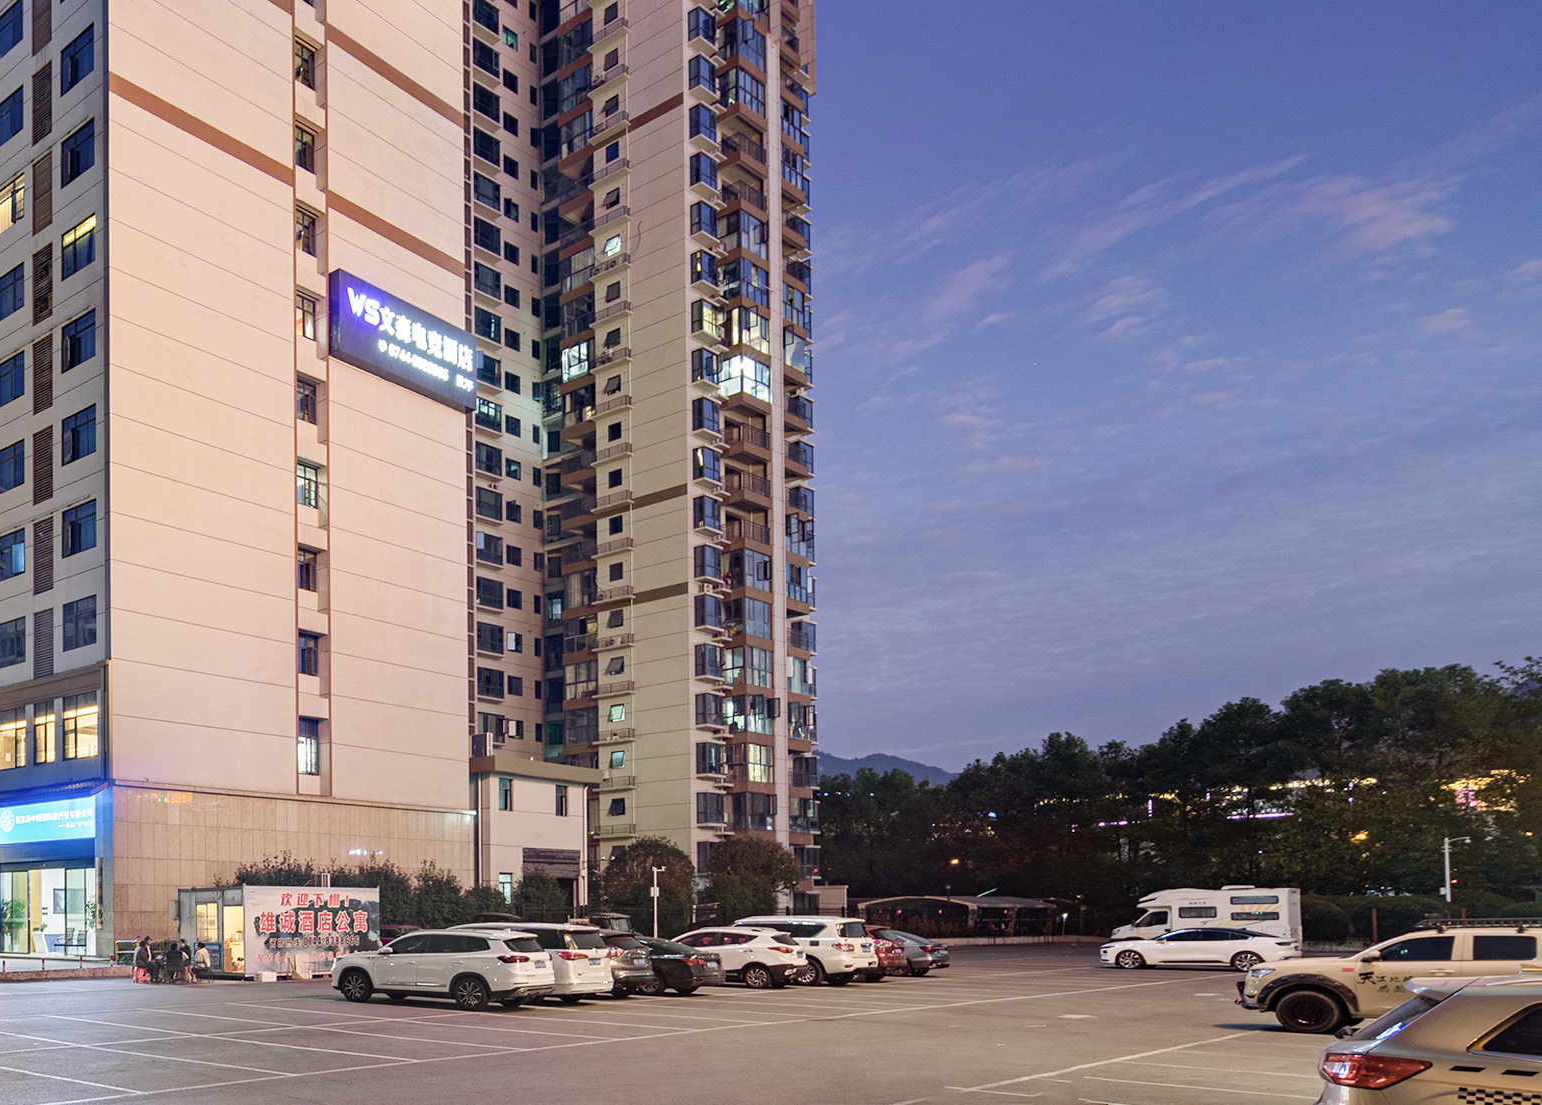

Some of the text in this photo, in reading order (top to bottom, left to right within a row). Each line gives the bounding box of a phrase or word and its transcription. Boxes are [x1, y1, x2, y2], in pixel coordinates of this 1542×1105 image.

[347, 286, 380, 326] WS
[260, 911, 368, 933] 雄诚酒店公寓
